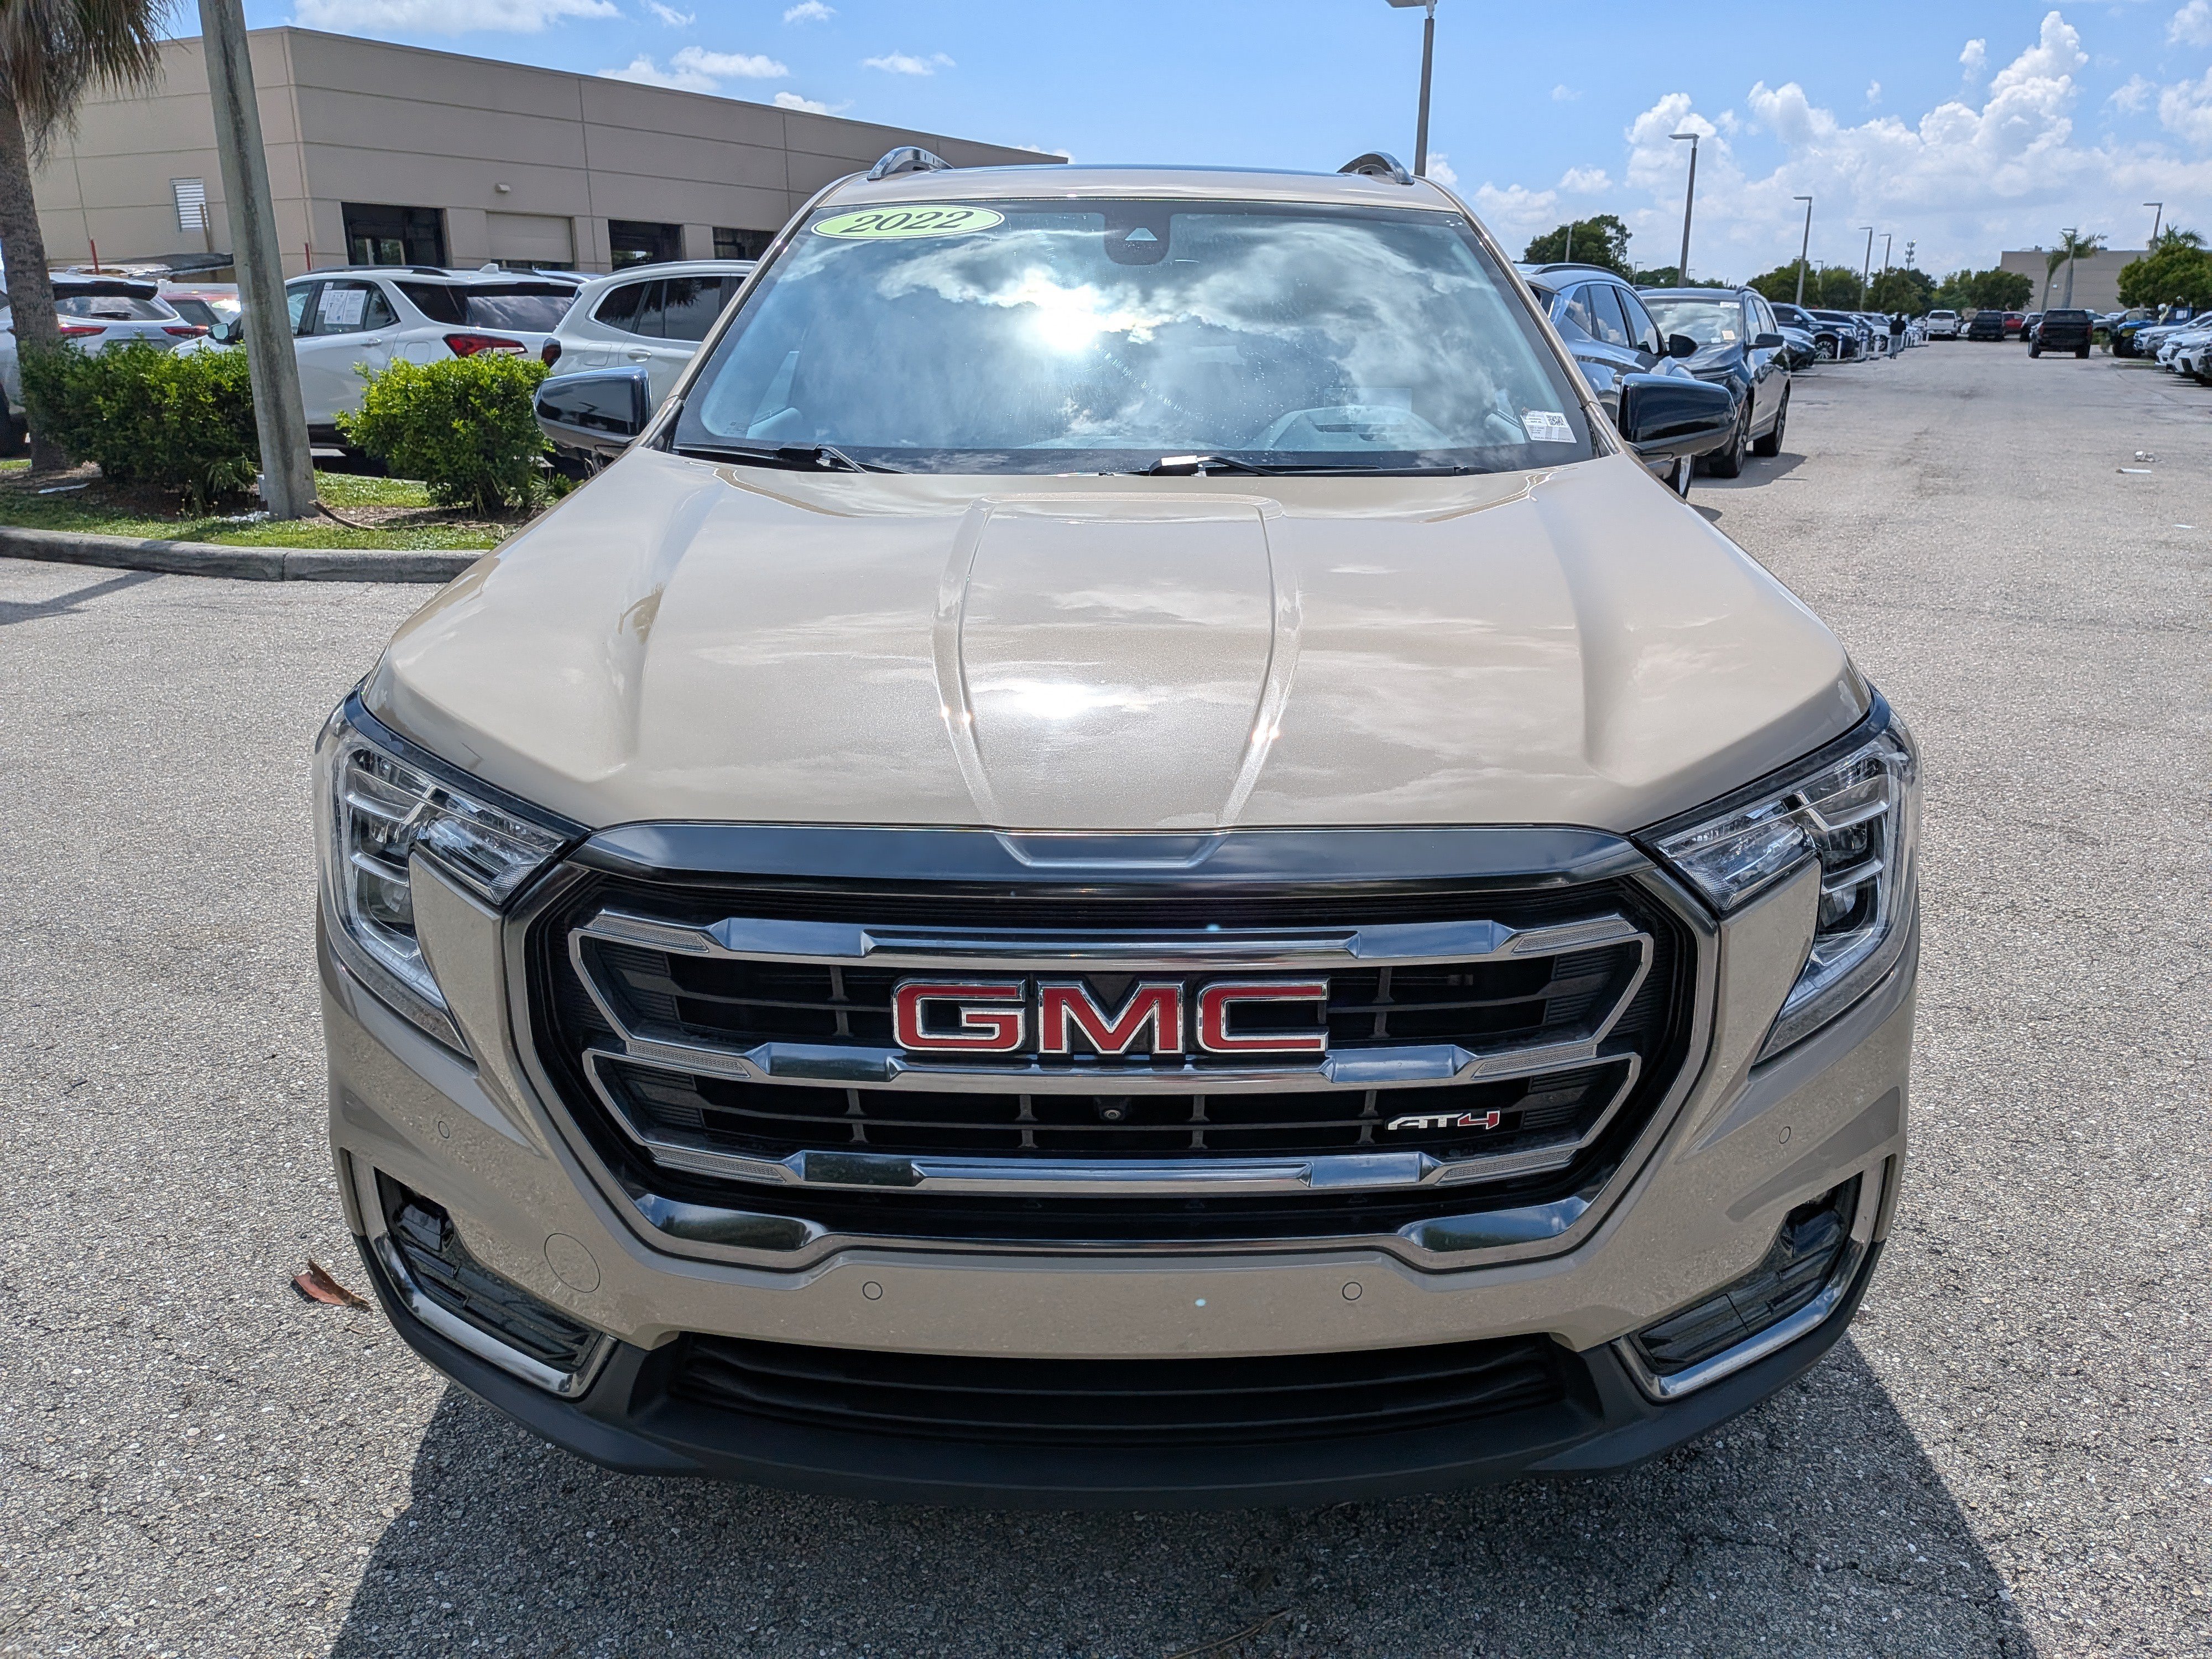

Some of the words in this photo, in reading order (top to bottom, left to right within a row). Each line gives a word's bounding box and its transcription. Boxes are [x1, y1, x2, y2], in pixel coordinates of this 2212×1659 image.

[838, 211, 974, 233] 2022
[892, 978, 1330, 1055] GMC
[1387, 1110, 1500, 1130] AT4
